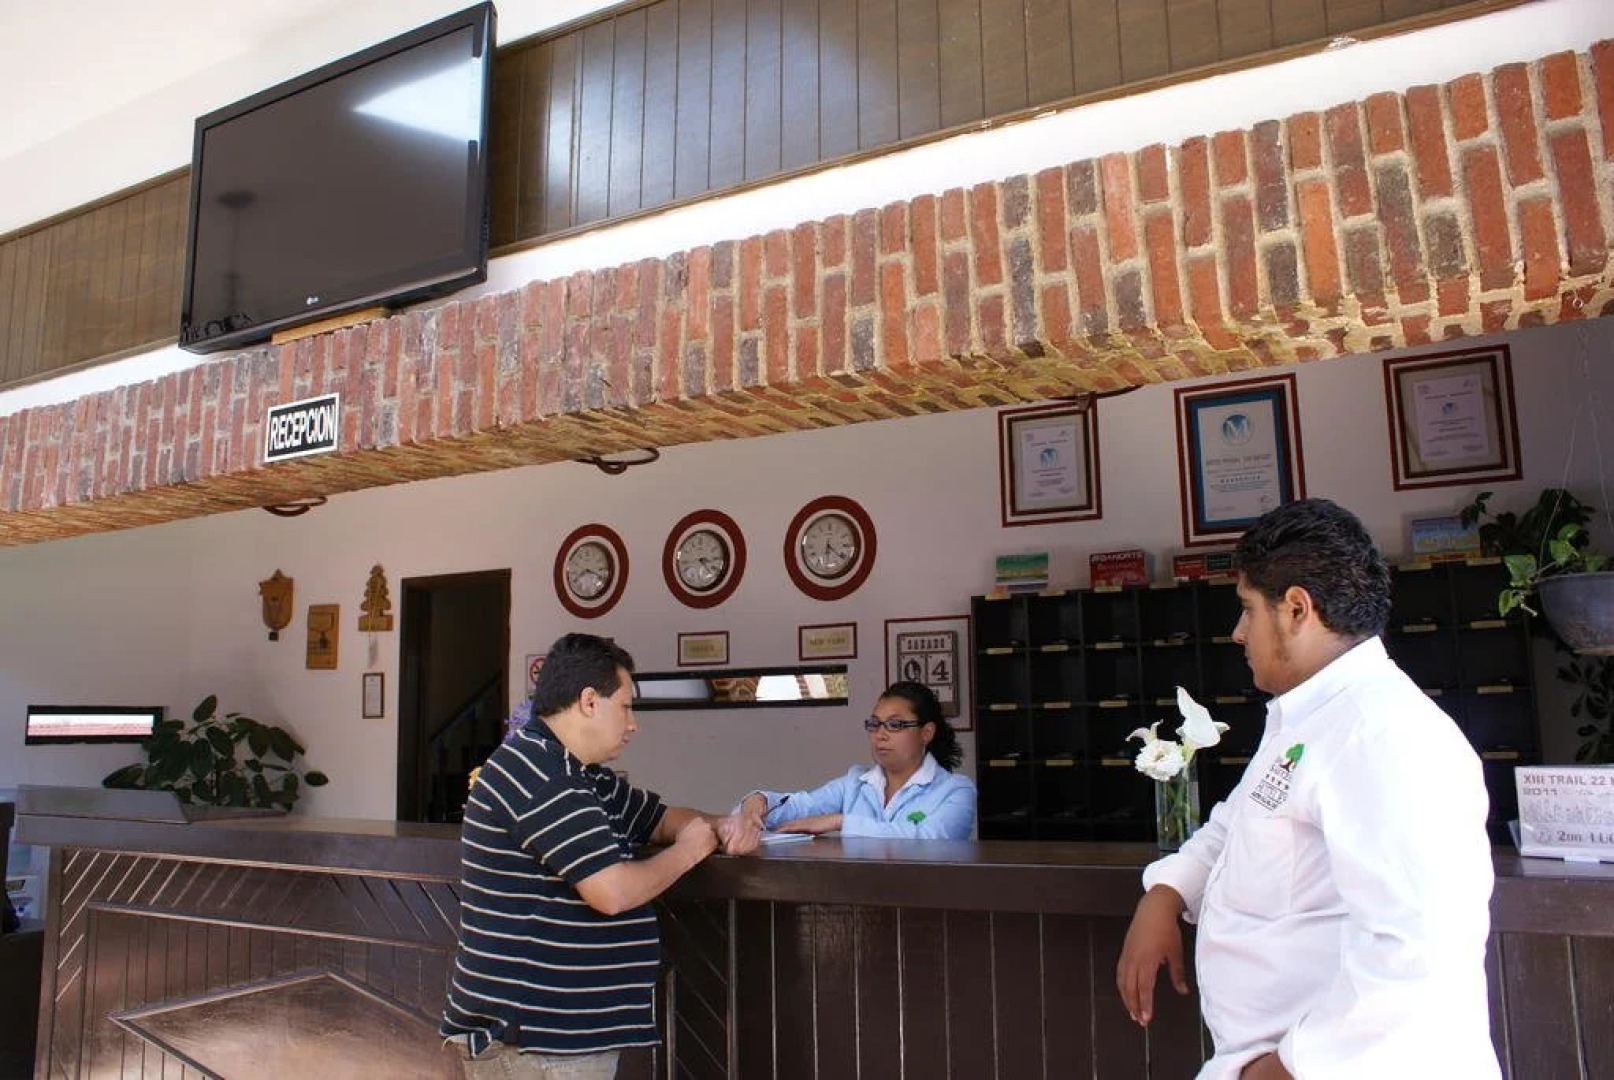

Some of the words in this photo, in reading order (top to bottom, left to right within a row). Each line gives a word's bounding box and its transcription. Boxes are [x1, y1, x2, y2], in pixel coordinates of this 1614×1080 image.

[269, 404, 336, 452] RECEPCION
[1548, 775, 1588, 786] TRAIL
[1591, 776, 1606, 786] 22
